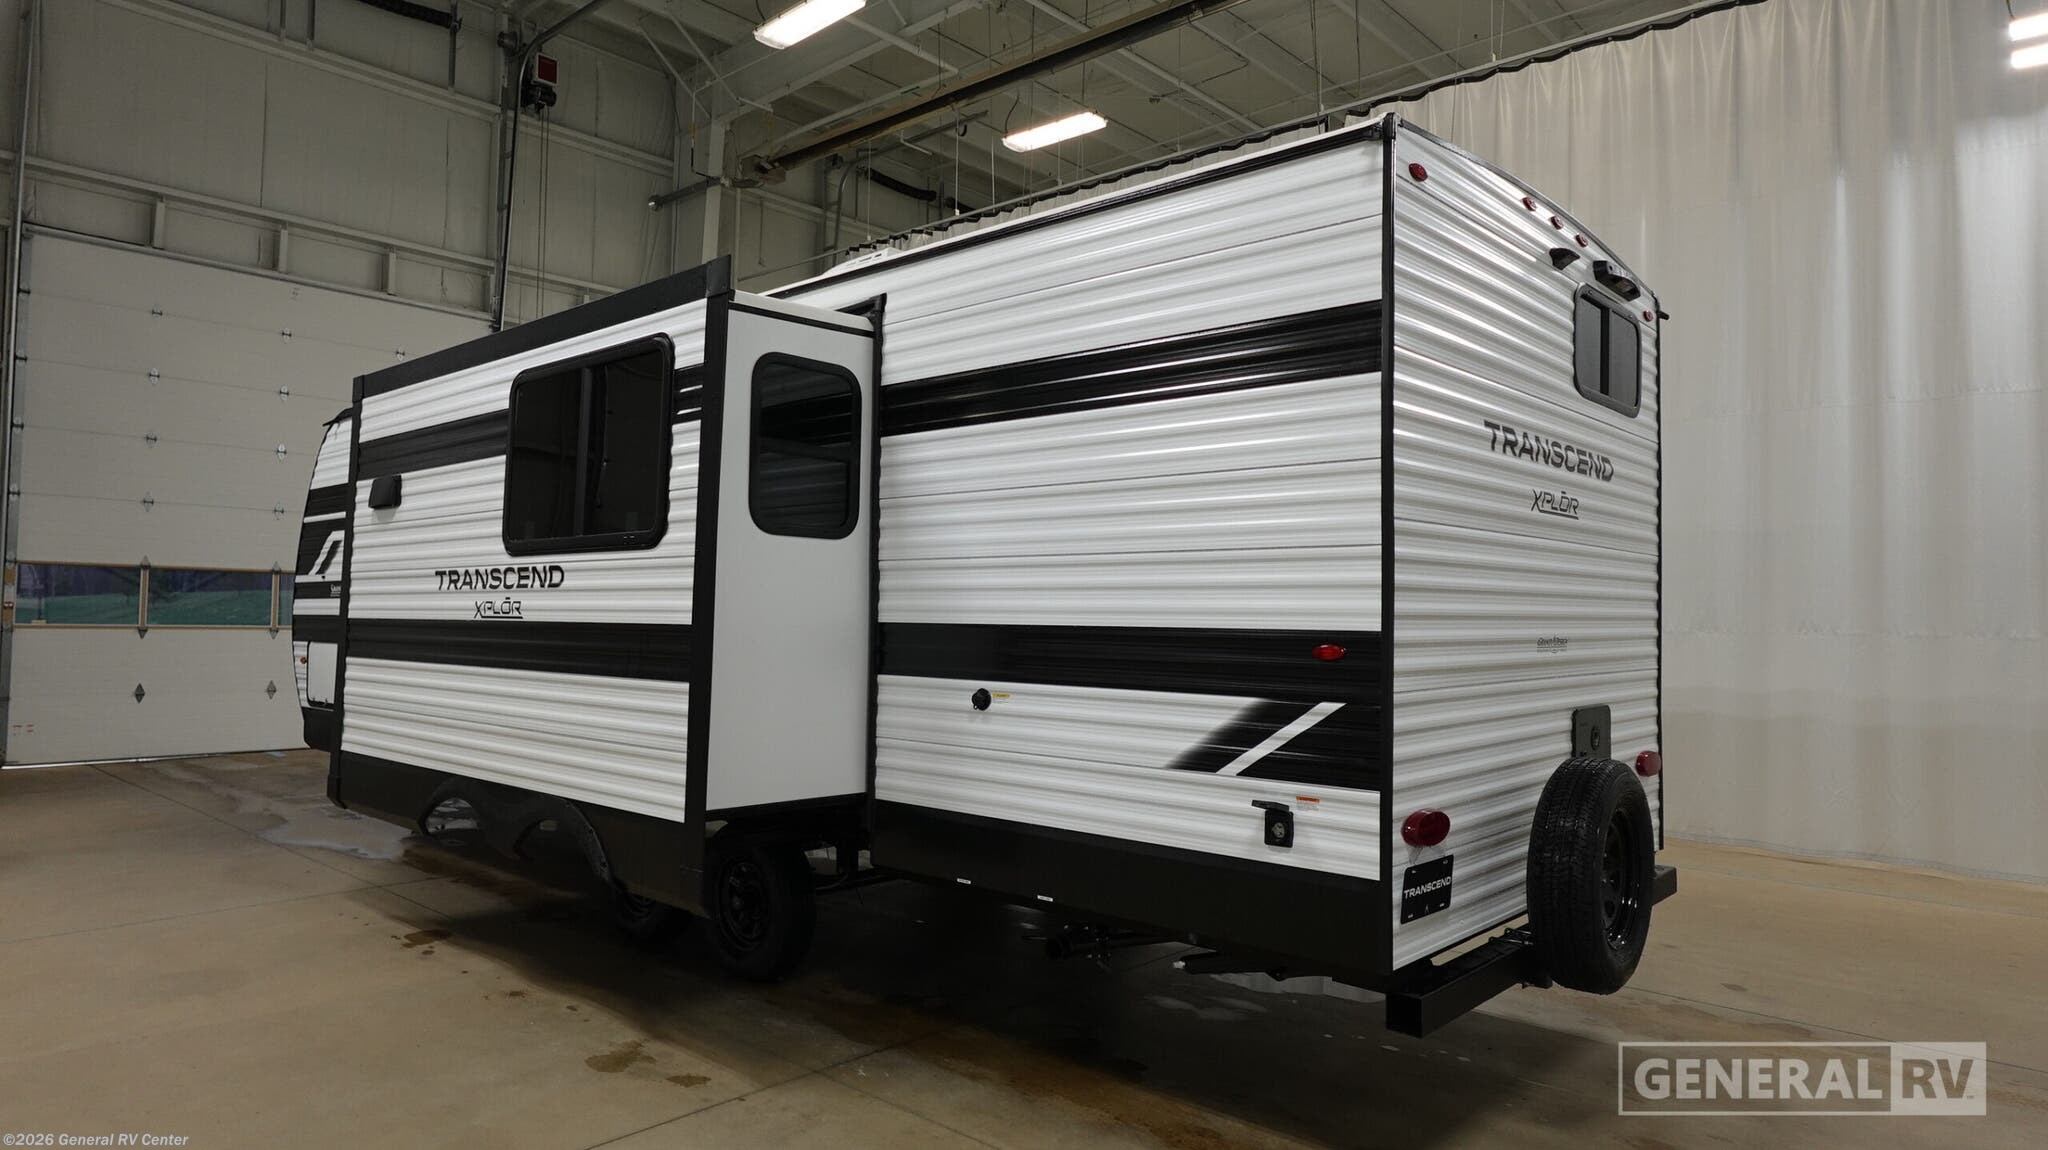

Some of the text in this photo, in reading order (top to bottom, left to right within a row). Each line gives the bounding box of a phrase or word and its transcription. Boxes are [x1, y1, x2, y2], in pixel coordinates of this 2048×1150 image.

[1484, 419, 1614, 482] TRANSCEND
[435, 565, 565, 591] TRANSCEND
[1404, 876, 1451, 899] TRANSCEND
